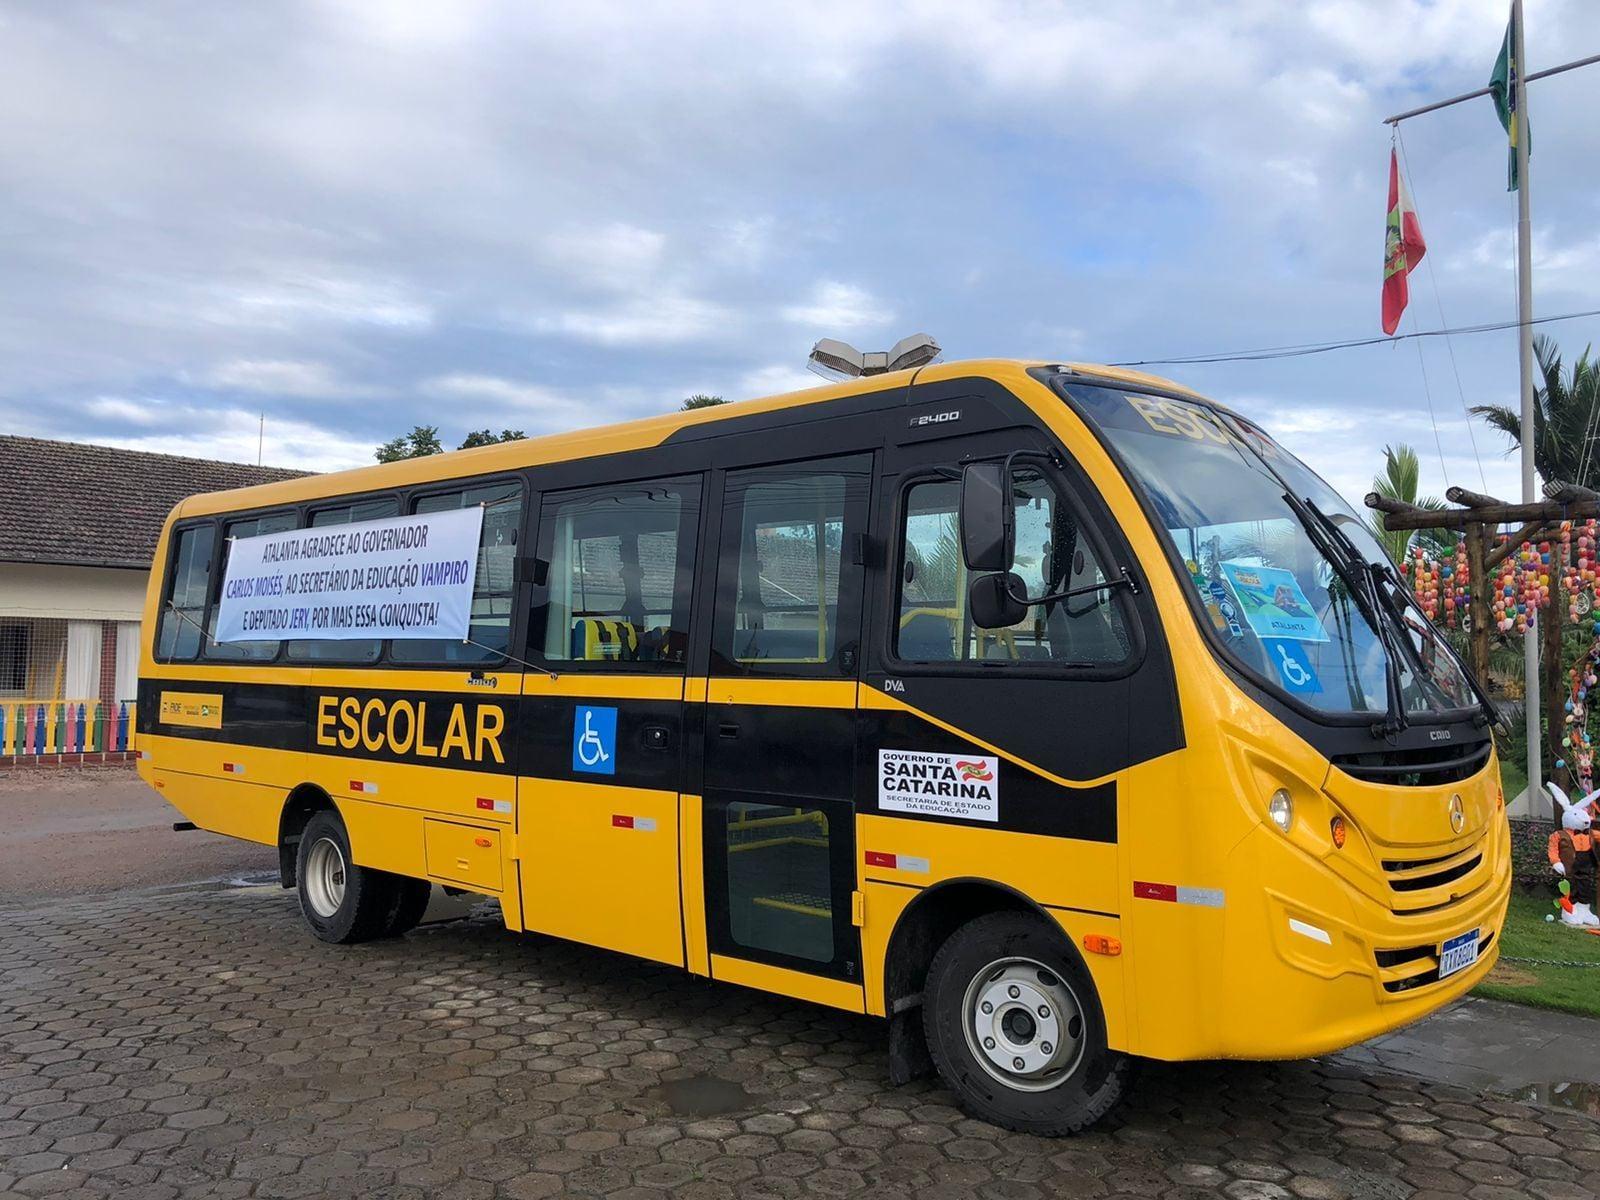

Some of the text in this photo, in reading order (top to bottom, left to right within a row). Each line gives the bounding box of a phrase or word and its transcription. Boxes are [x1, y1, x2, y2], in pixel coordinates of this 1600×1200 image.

[910, 410, 960, 426] F2400
[262, 524, 429, 563] ATALANTA AGRADECE AO GOVERNADOR
[226, 558, 469, 599] CARLOS MOISÉS, AO SECRETÁRIO DA EDUCAÇÃO VAMPIRO
[243, 602, 440, 632] E DEPUTADO JERY, POR MAIS ESSA CONQUISTA!
[884, 679, 905, 692] DVA
[317, 695, 505, 763] ESCOLAR
[883, 753, 951, 765] GOVERNO DE
[883, 762, 957, 781] SANTA
[883, 777, 992, 801] CATARINA
[886, 795, 938, 806] SECRETARIA
[955, 802, 991, 811] ESTADO
[920, 804, 969, 815] EDUCAÇÃO
